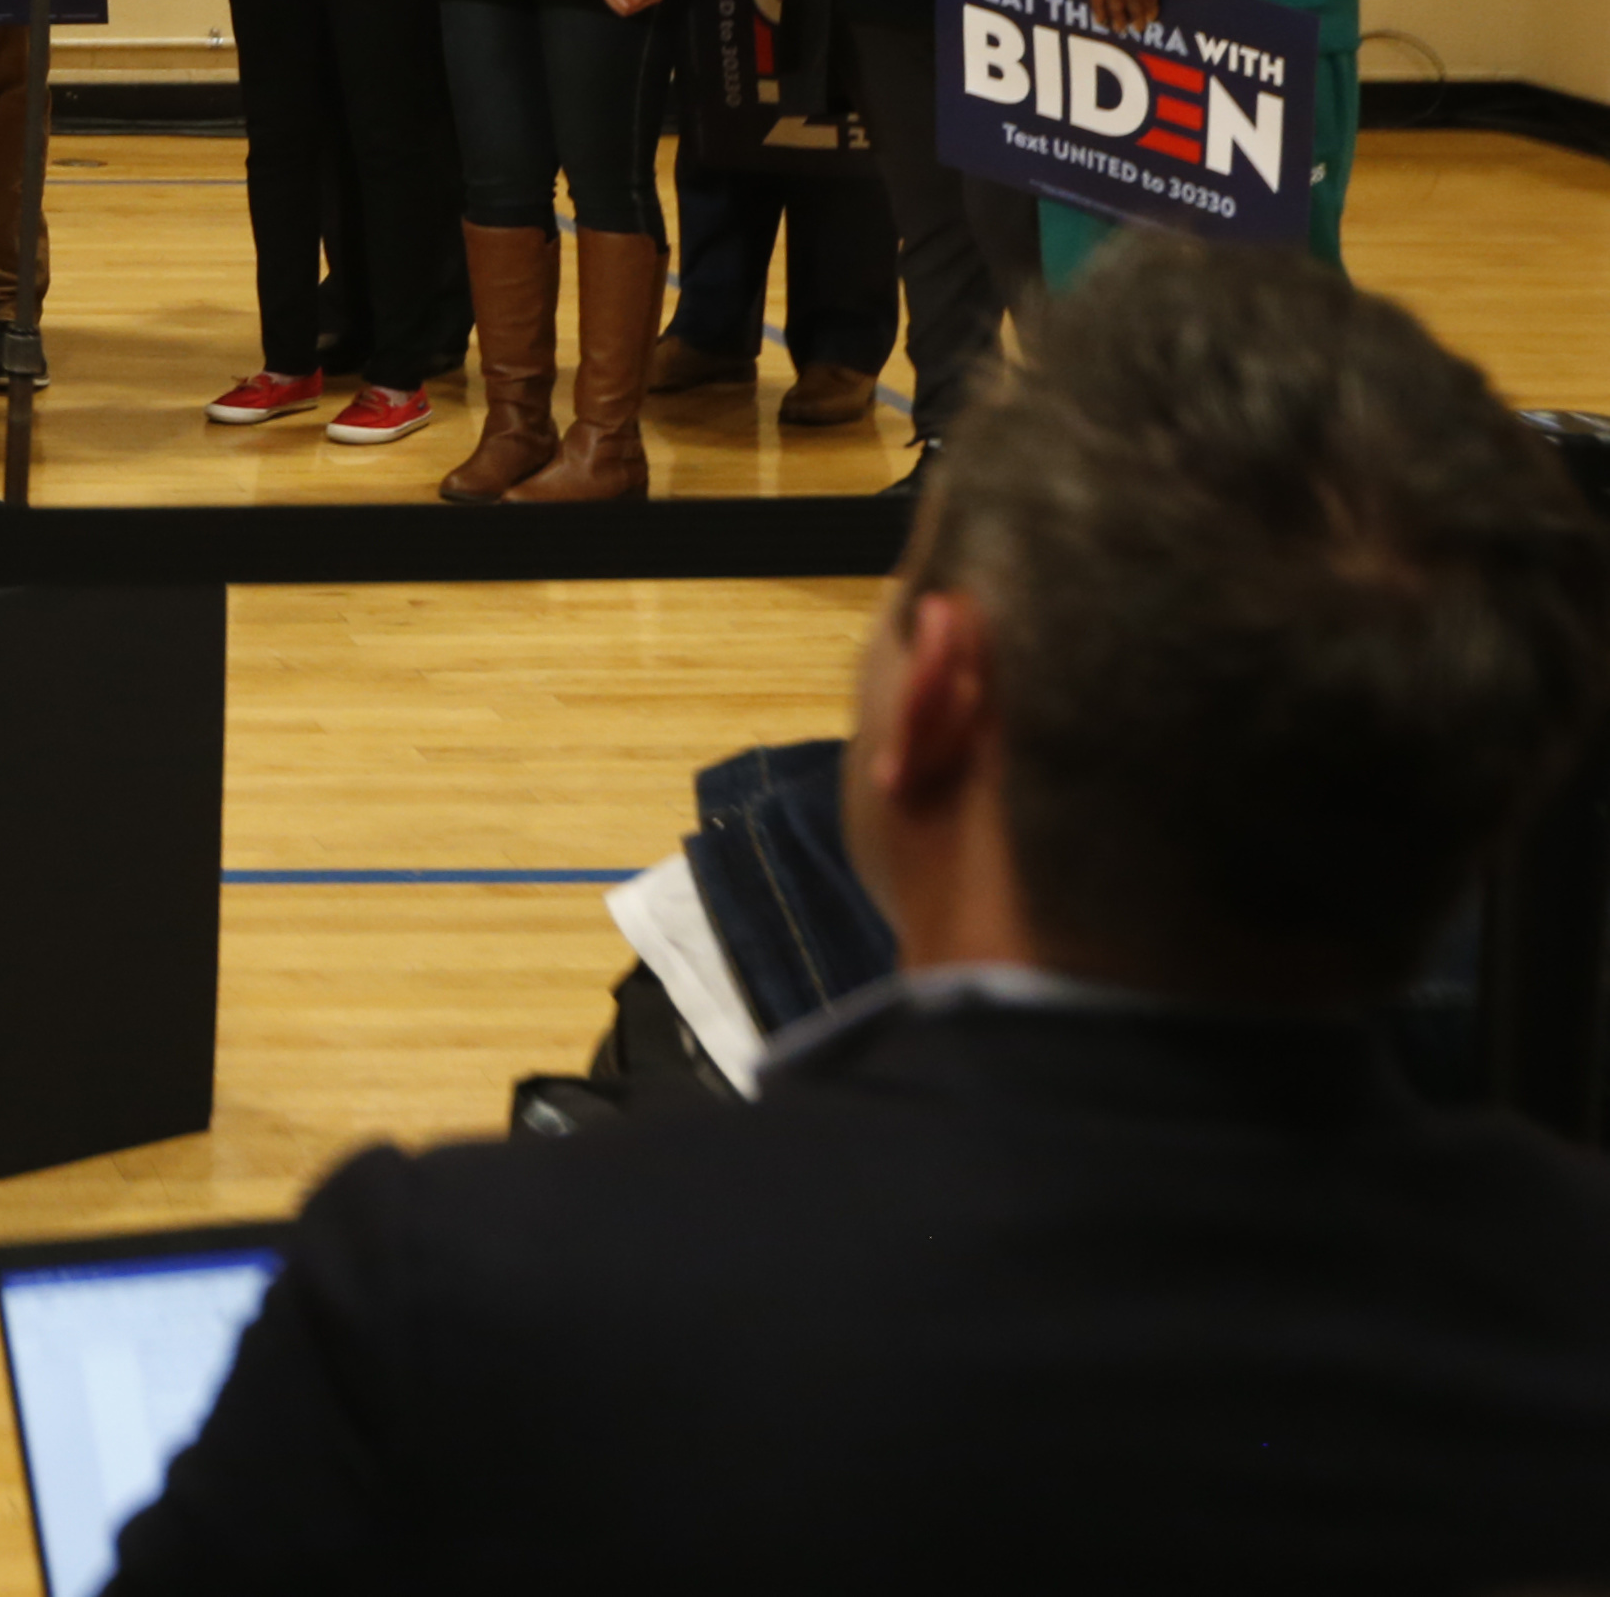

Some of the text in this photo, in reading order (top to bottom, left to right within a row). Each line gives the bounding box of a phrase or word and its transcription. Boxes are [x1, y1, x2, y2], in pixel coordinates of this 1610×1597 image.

[963, 3, 1284, 194] BIDEN
[1194, 30, 1285, 86] WITH
[1002, 122, 1236, 219] Text UNITED to 30330
